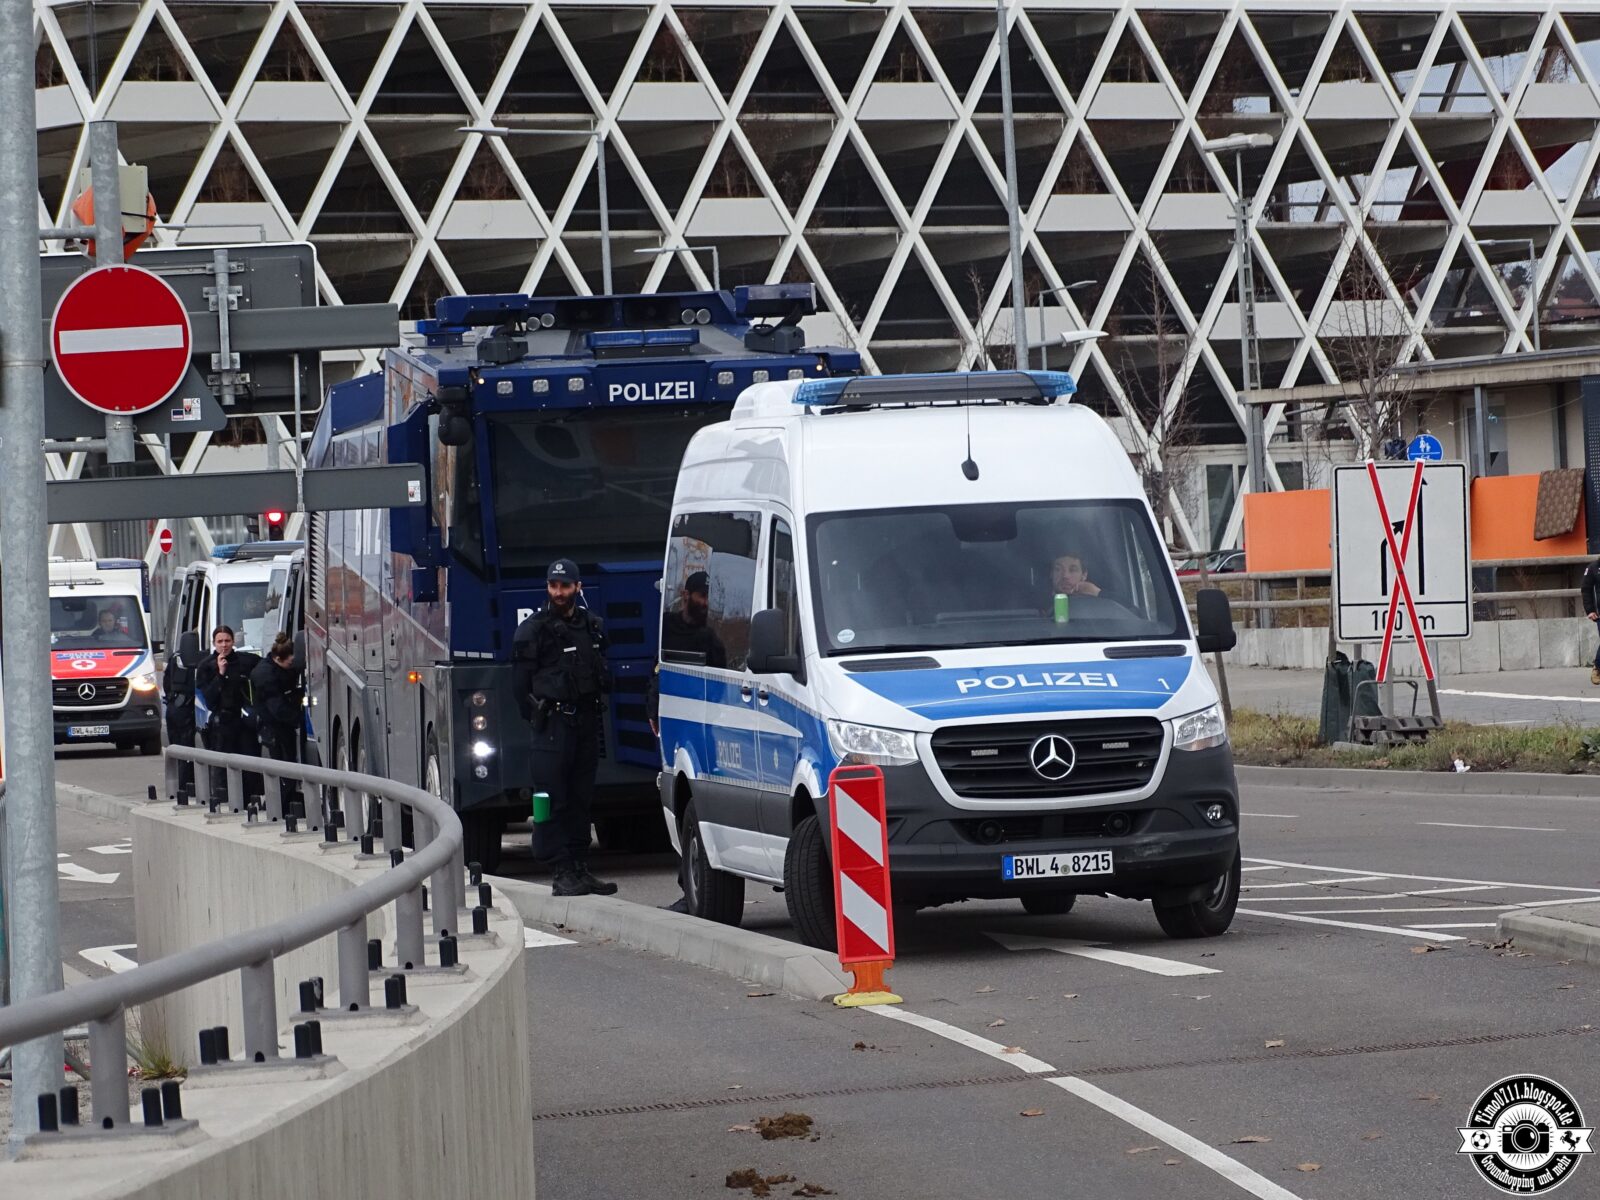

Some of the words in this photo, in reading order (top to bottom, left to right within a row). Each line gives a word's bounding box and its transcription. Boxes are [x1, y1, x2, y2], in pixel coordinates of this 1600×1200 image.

[608, 381, 695, 402] POLIZEI
[955, 672, 1119, 694] POLIZEI
[1157, 677, 1170, 690] 1
[717, 740, 743, 768] POLIZEI
[1014, 857, 1046, 876] BWL
[1050, 856, 1059, 874] 4
[1072, 853, 1111, 873] 8215
